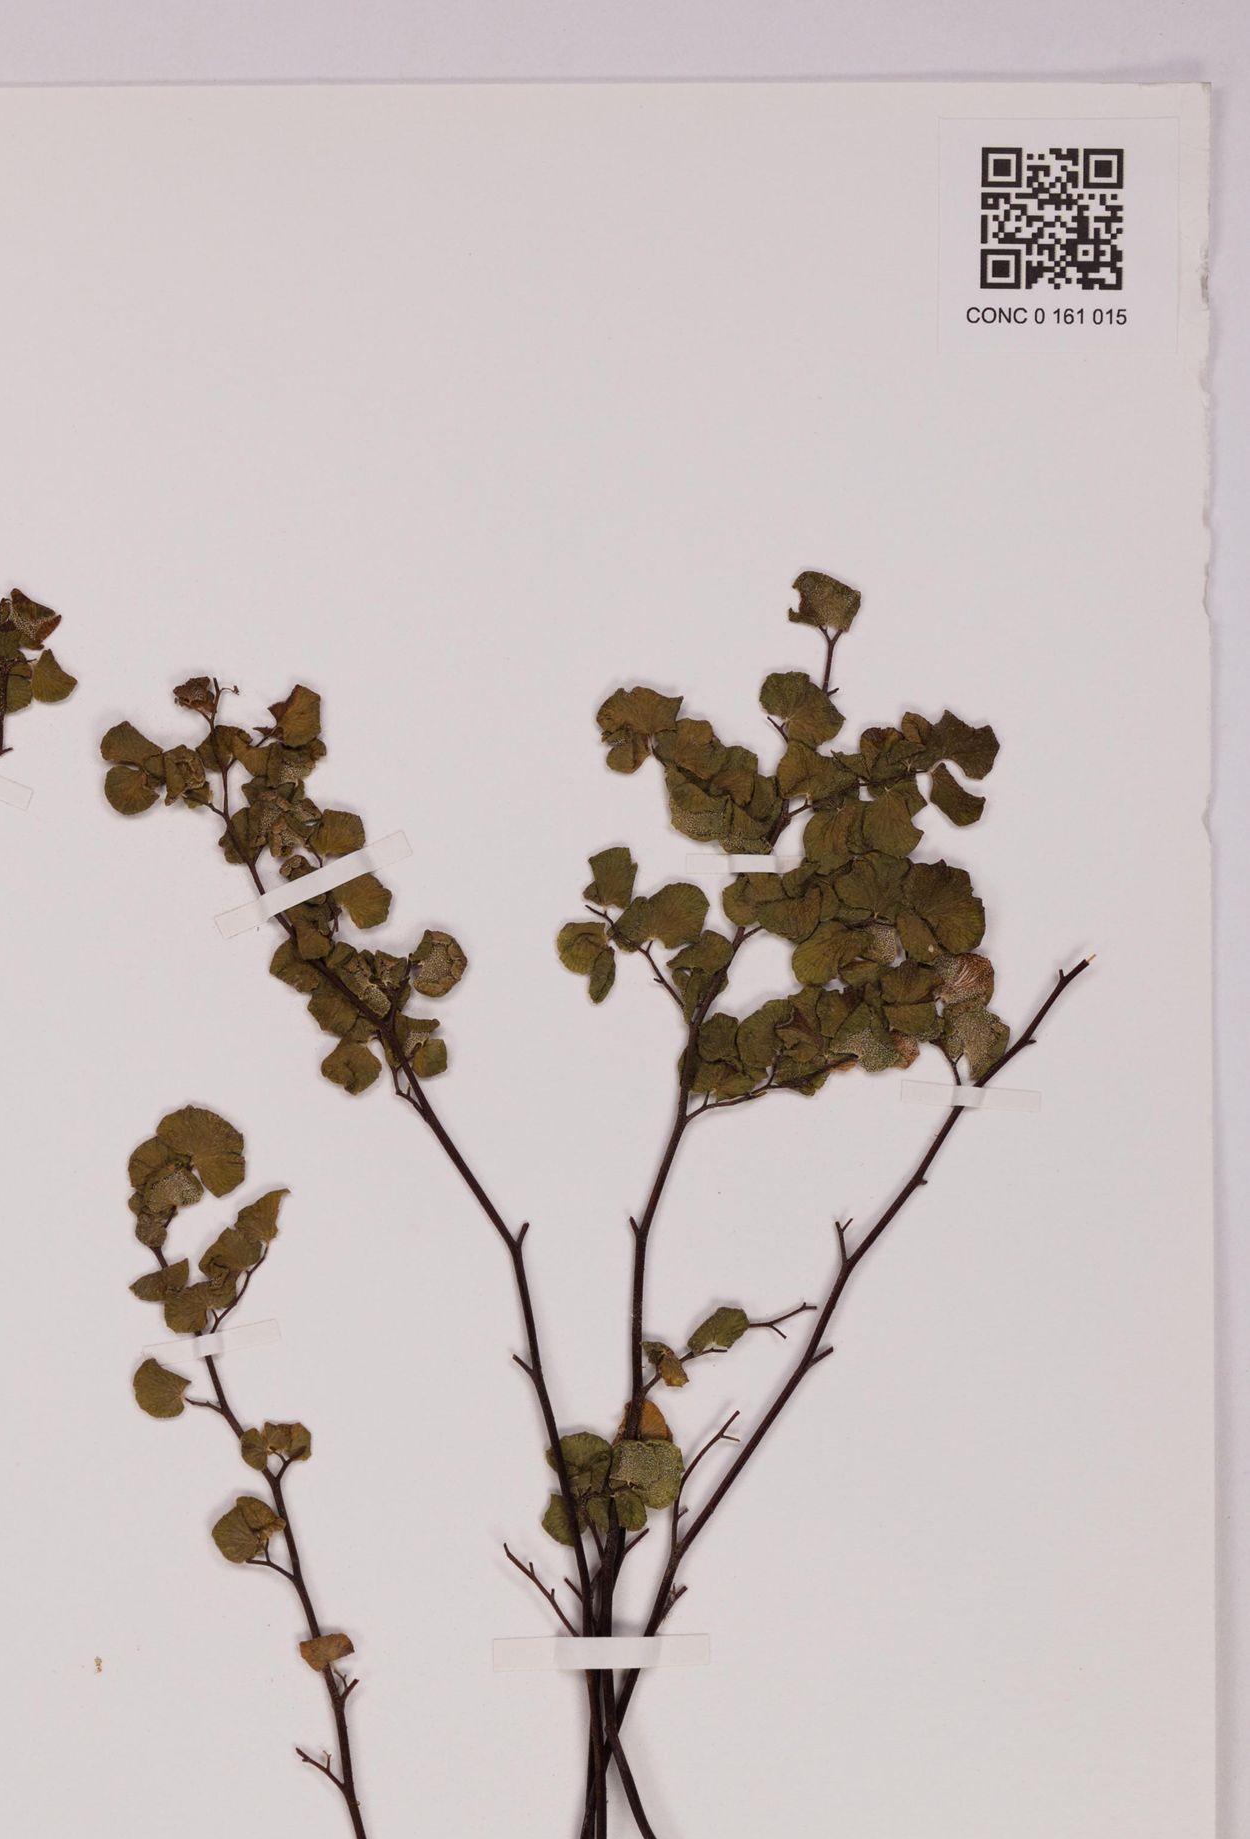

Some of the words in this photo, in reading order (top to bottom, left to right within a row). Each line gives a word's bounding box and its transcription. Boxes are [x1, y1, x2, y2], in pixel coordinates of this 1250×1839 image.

[966, 306, 1028, 325] CONC
[1034, 307, 1046, 325] 0
[1052, 307, 1084, 325] 161
[1092, 308, 1128, 326] 015
